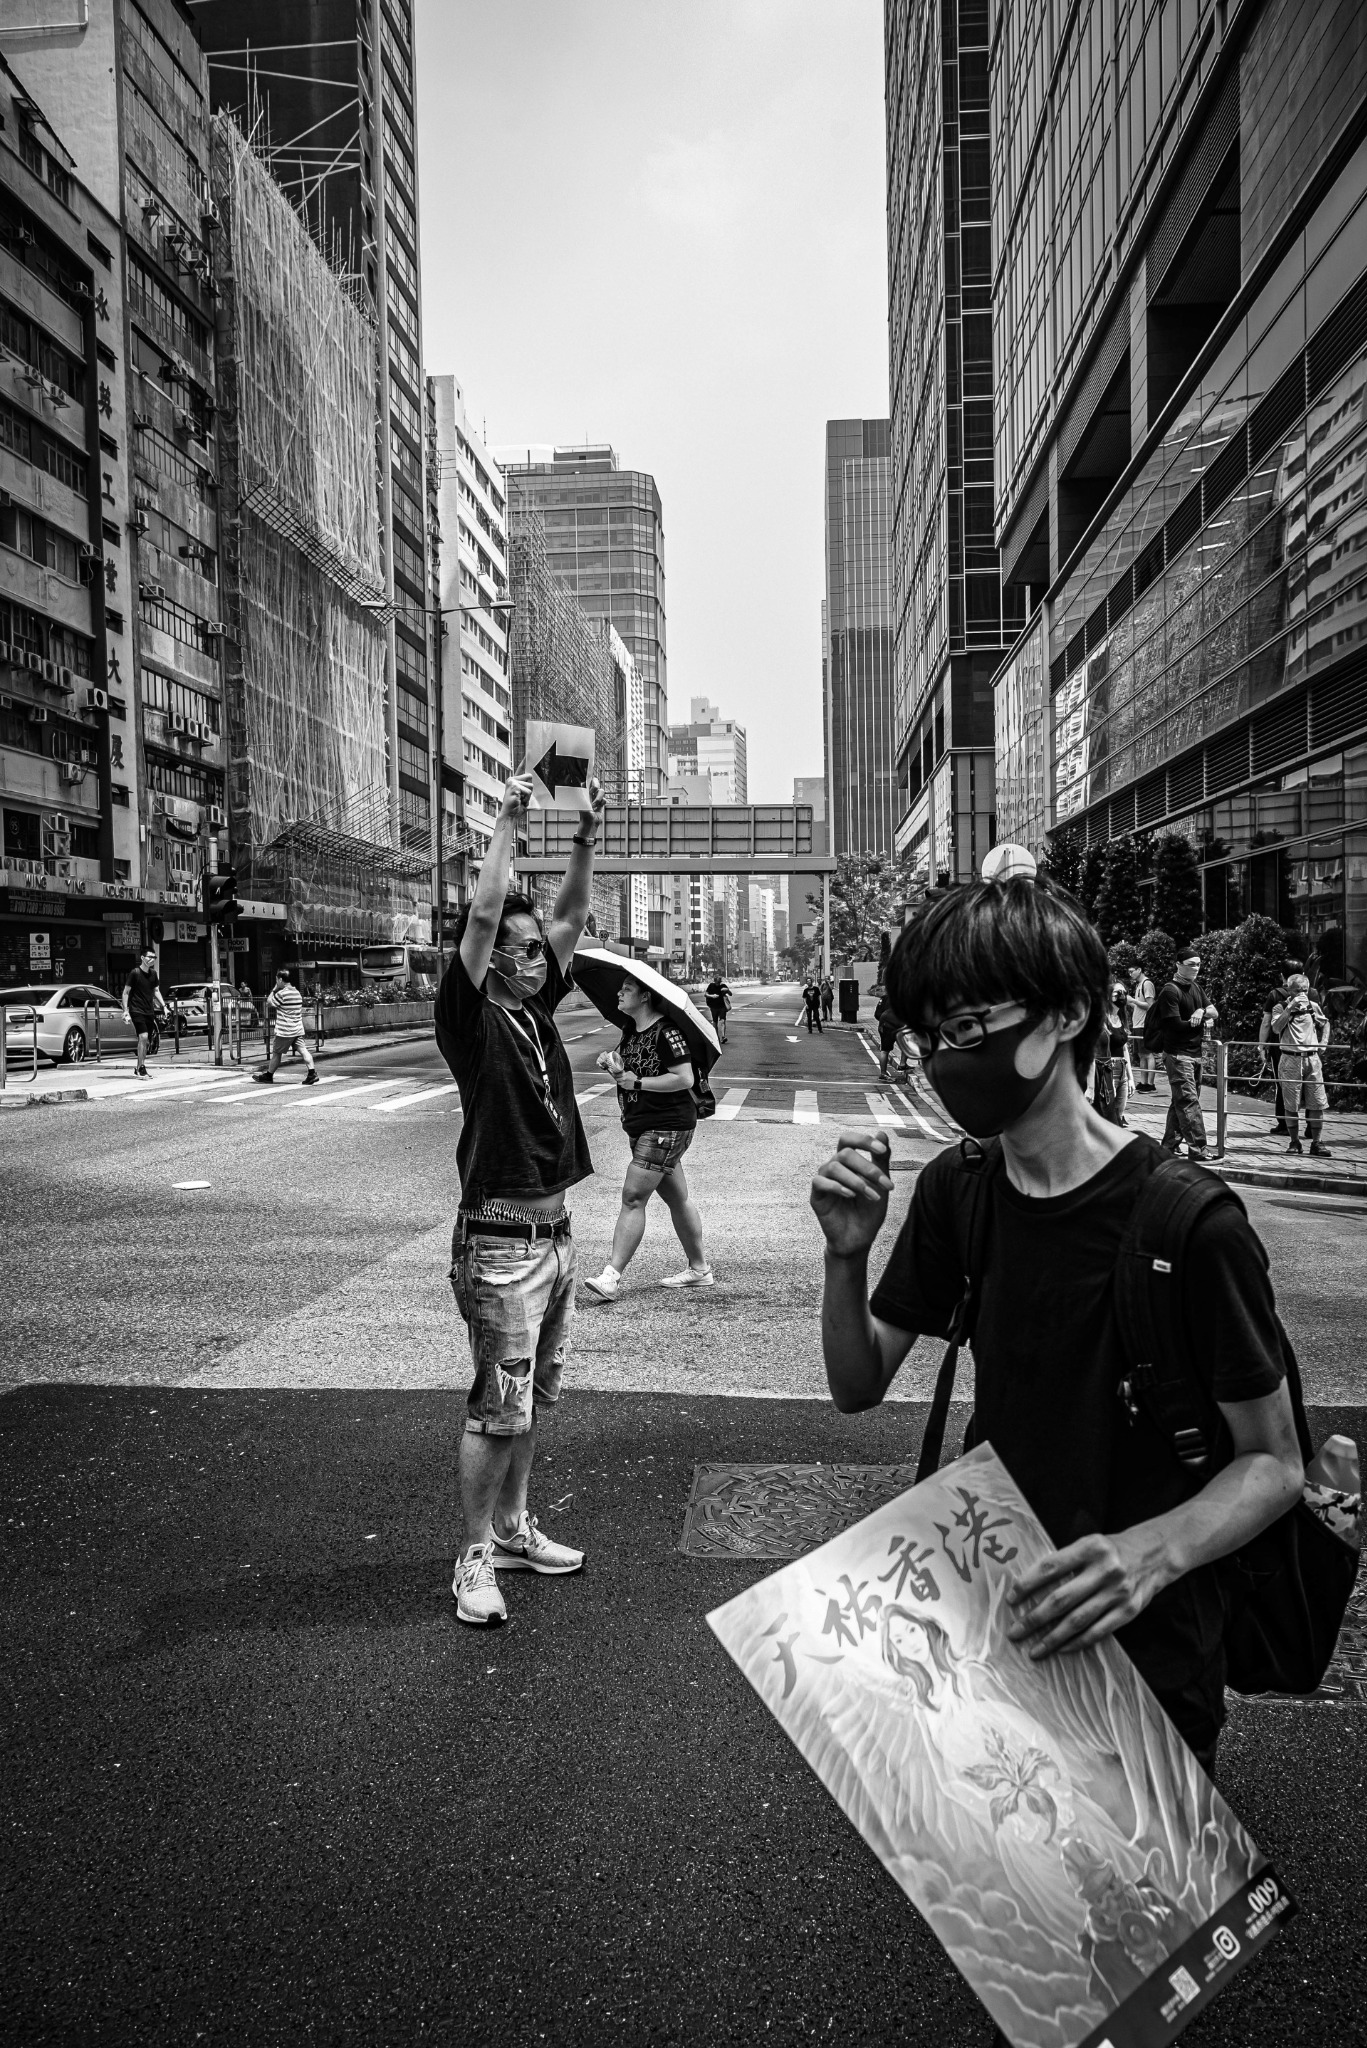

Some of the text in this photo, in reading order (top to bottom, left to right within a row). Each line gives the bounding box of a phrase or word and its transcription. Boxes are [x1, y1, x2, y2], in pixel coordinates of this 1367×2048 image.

[154, 846, 163, 861] 81
[25, 873, 188, 905] WING YING INDUSTRIAL BUILDING
[55, 962, 64, 976] 95
[761, 1486, 1018, 1701] 天祐香港
[1248, 1877, 1279, 1914] 009
